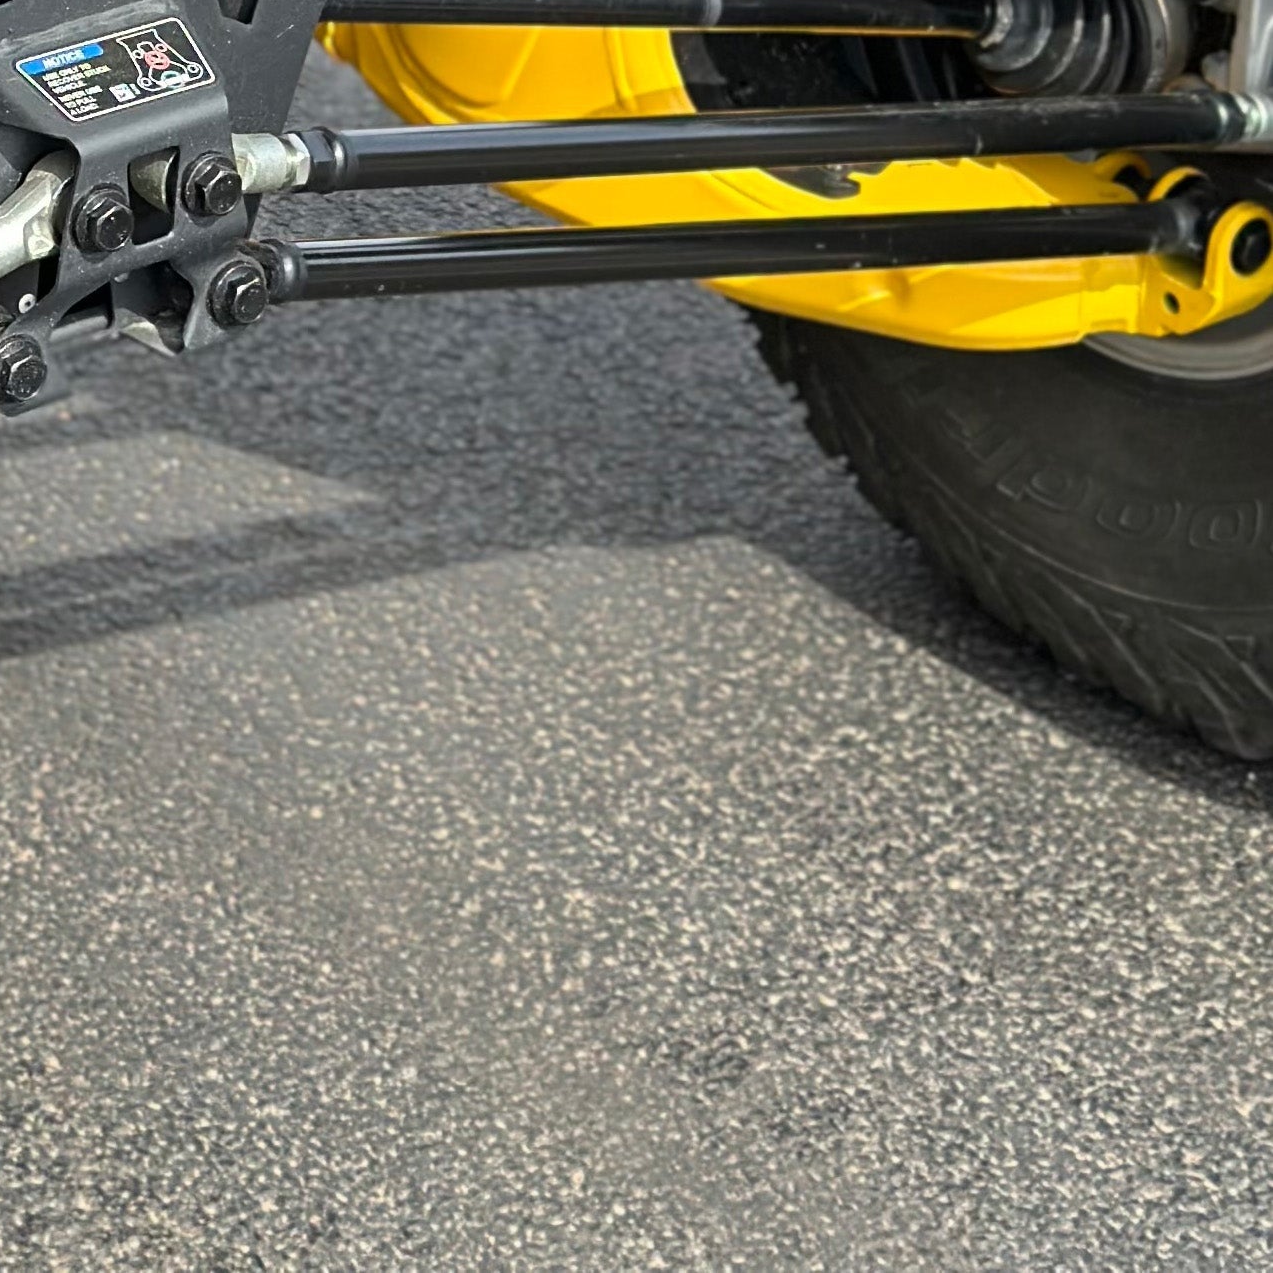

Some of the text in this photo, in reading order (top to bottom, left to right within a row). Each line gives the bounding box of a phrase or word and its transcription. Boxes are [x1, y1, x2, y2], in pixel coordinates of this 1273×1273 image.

[42, 49, 84, 69] NOTICE
[47, 65, 111, 87] RECOVER STUCK
[59, 66, 78, 76] ONLY
[76, 96, 97, 106] PULL
